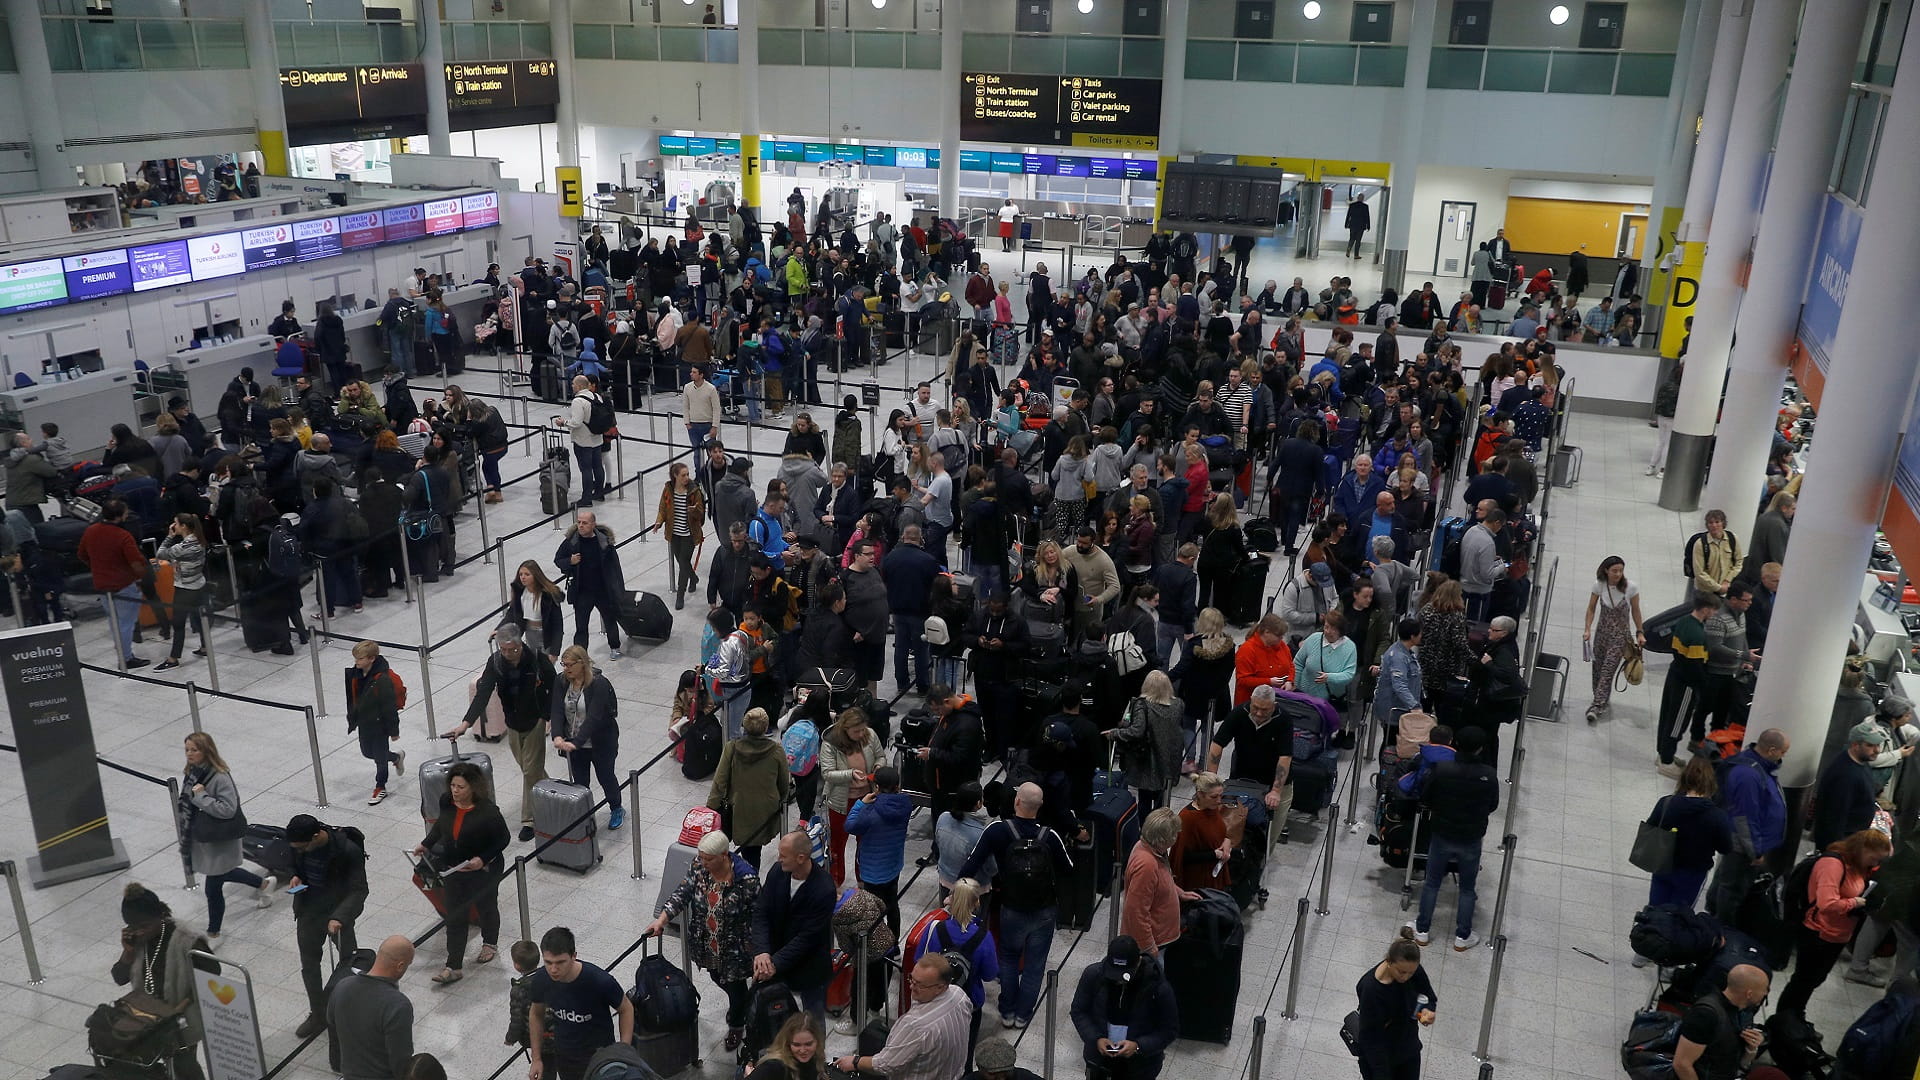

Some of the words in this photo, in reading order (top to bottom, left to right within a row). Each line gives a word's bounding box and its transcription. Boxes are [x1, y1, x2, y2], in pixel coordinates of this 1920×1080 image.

[381, 68, 408, 80] Arrivals
[463, 65, 482, 76] North
[482, 64, 509, 75] Terminal
[528, 63, 540, 74] Exit
[302, 71, 348, 85] Departures
[986, 75, 1000, 84] Exit
[1083, 79, 1102, 87] Taxis
[464, 81, 480, 91] Train
[481, 80, 502, 91] station
[986, 87, 1007, 95] North
[1008, 87, 1039, 96] Terminal
[1083, 90, 1096, 98] Car
[1096, 91, 1117, 100] parks
[986, 98, 1004, 106] Train
[1004, 99, 1029, 107] station
[1083, 102, 1101, 110] Valet
[1102, 103, 1131, 113] parking
[986, 109, 1037, 118] Buses/coaches
[1082, 113, 1095, 121] Car
[1096, 114, 1117, 122] rental
[1089, 135, 1113, 144] Toilets
[897, 151, 925, 161] 10:03
[748, 157, 758, 175] F
[562, 180, 578, 205] E
[345, 216, 368, 224] TURKISH
[346, 221, 368, 230] AIRLINES
[249, 231, 275, 239] TURKISH
[250, 238, 275, 246] AIRLINES
[82, 271, 116, 284] PREMIUM
[1818, 253, 1850, 308] AIRCRAF
[1672, 277, 1699, 307] D
[12, 645, 64, 661] vueling
[21, 663, 64, 675] PREMIUM
[21, 671, 65, 683] CHECK-IN
[29, 697, 67, 708] PREMIUM
[554, 1009, 592, 1022] didas
